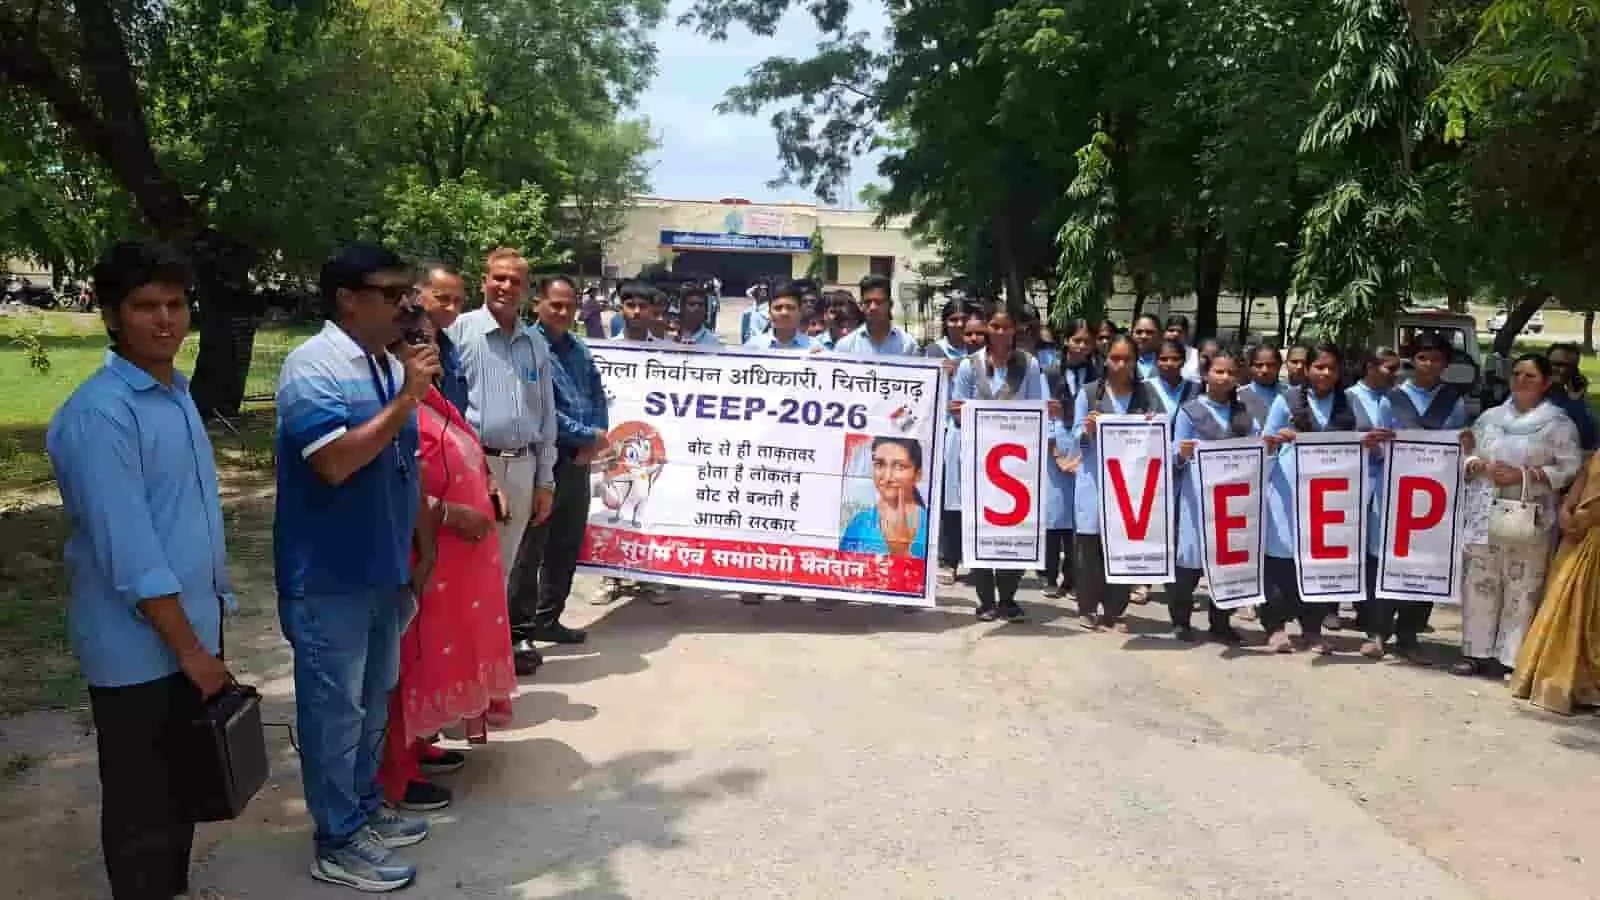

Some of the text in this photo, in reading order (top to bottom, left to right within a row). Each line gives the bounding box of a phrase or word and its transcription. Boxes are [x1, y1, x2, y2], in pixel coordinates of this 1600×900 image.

[645, 358, 721, 384] निर्वाचन
[644, 391, 868, 430] SVEEP-2026
[687, 436, 712, 456] वोट
[718, 439, 730, 456] से
[737, 439, 751, 460] ही
[696, 460, 729, 481] होता
[735, 462, 744, 482] है
[983, 443, 1031, 527] S
[696, 484, 721, 502] वोट
[727, 486, 739, 504] से
[789, 490, 800, 512] है
[1106, 458, 1162, 540] V
[694, 509, 799, 532] आपकी सरकार
[1213, 481, 1250, 565] E
[1310, 477, 1349, 559] E
[1393, 475, 1447, 558] P
[677, 542, 706, 567] एवं
[711, 546, 795, 574] समावेशी
